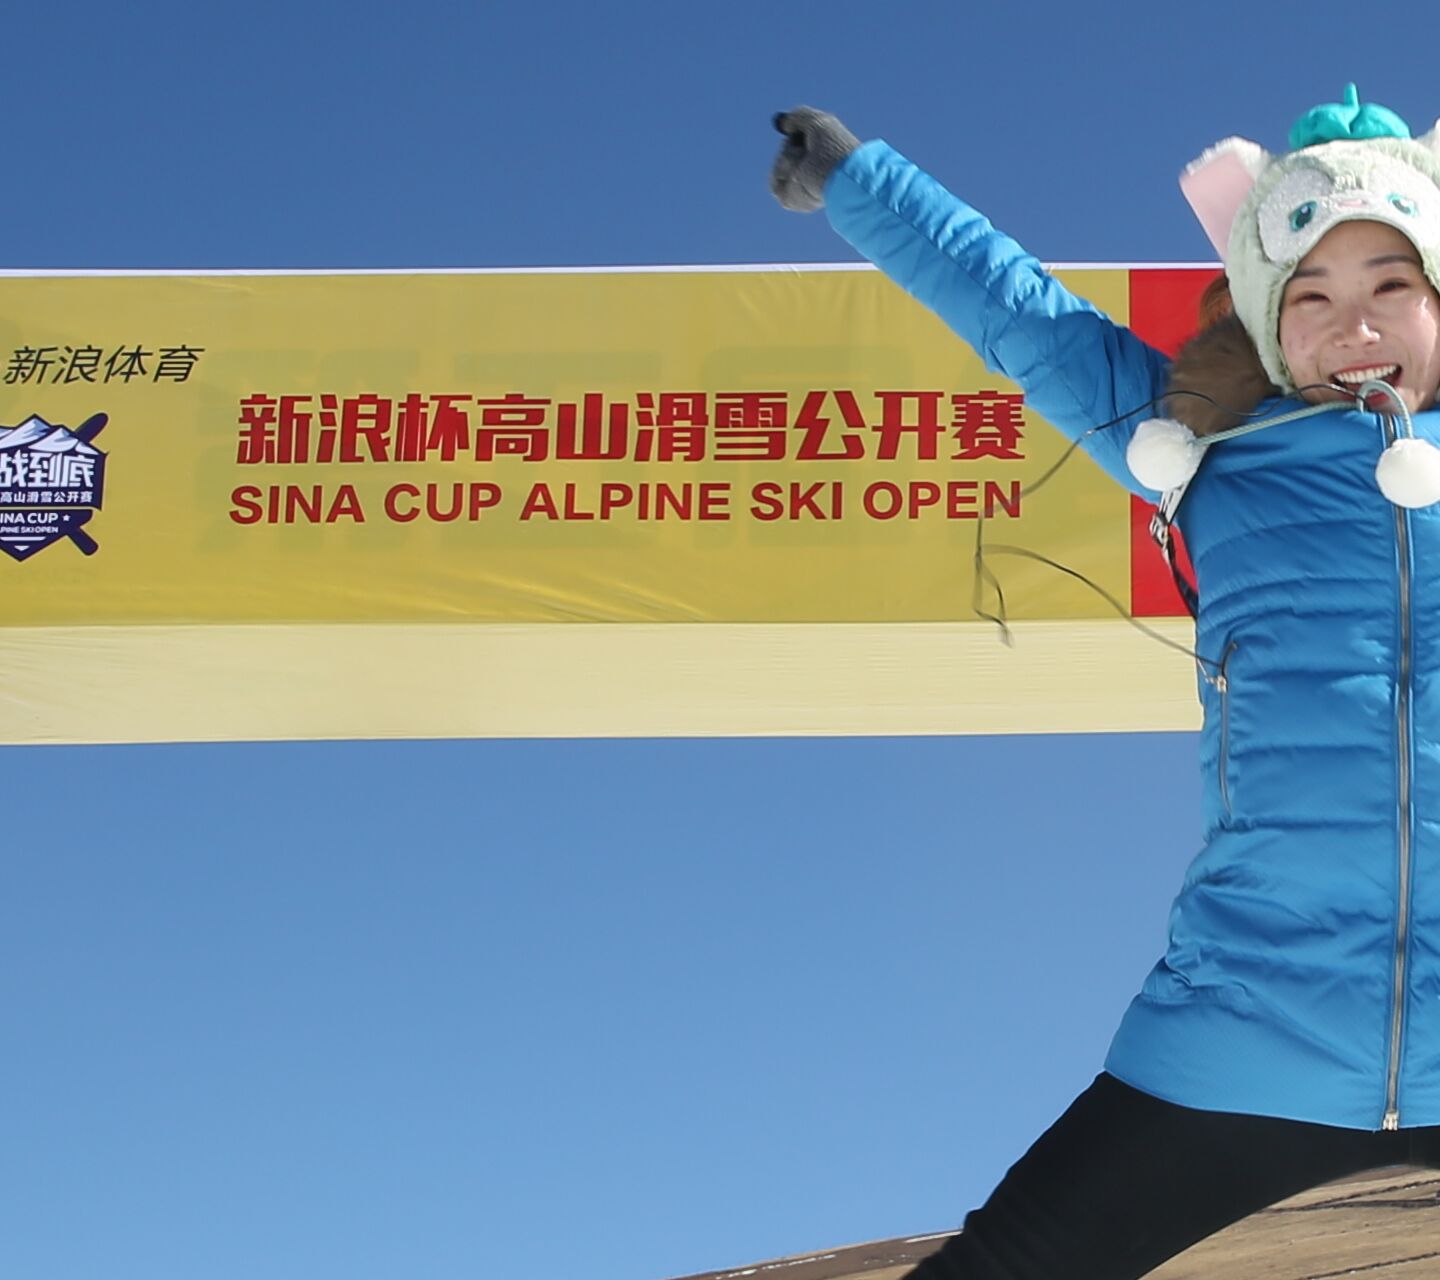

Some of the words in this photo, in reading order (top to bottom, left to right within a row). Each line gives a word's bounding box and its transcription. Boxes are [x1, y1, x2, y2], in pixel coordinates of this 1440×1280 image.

[2, 345, 205, 385] 新浪体育
[236, 391, 1026, 464] 新浪杯高山滑雪公开赛
[27, 513, 59, 524] CUP
[229, 484, 365, 524] SINA
[384, 482, 502, 523] CUP
[519, 482, 731, 521] ALPINE
[749, 481, 843, 521] SKI
[863, 480, 1021, 520] OPEN
